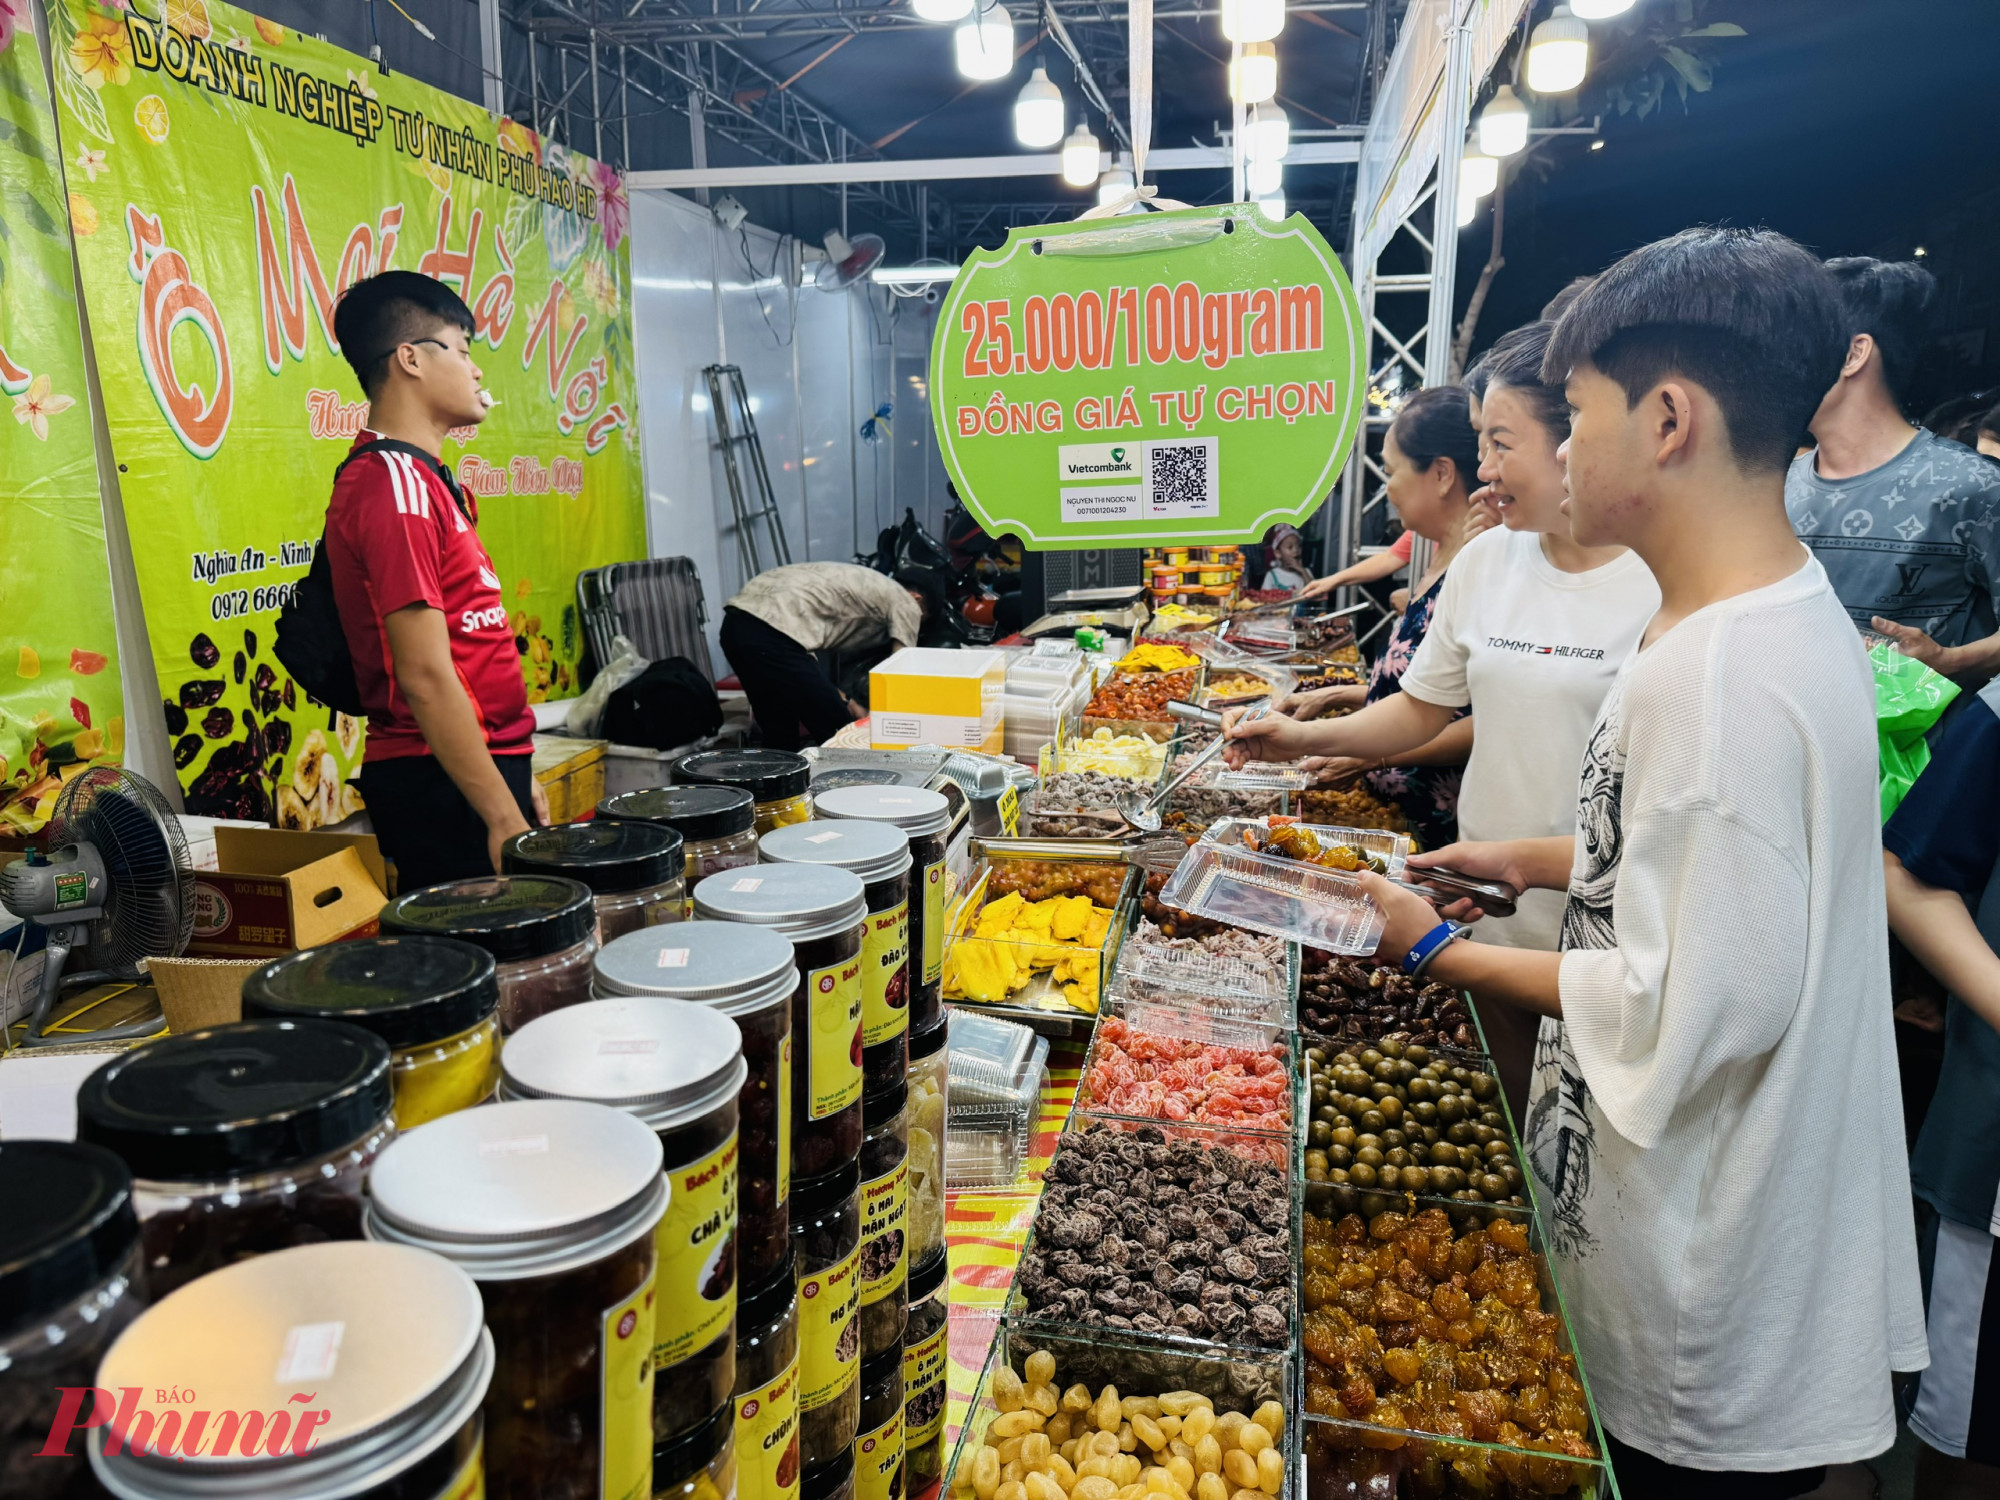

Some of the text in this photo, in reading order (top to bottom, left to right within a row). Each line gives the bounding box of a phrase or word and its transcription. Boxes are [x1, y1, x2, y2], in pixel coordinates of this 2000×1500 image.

[125, 10, 597, 220] DOANH NGHIỆP TƯ NHÂN PHÚ HÀO HD
[125, 202, 234, 461] Ô
[418, 194, 515, 350] Hà
[961, 280, 1324, 378] 25.000/100gram
[957, 380, 1335, 437] ĐỒNG GIÁ TỰ CHỌN
[1068, 461, 1132, 474] Vietcombank
[1066, 495, 1137, 505] NGUYEN THI NGOC NU
[1076, 506, 1127, 515] 0071001204230
[240, 546, 265, 573] An
[280, 540, 312, 567] Ninh
[210, 590, 249, 621] 0972
[460, 601, 506, 633] Snap
[1487, 637, 1605, 661] TOMMY HILFIGER
[881, 950, 900, 967] ĐÀO
[866, 1179, 895, 1200] Hương
[867, 1195, 894, 1217] Ô MAI
[690, 1209, 721, 1245] CHÀ
[861, 1217, 886, 1237] MẶN
[828, 1265, 850, 1287] Bách
[917, 1352, 939, 1373] Ô MAI
[878, 1454, 896, 1475] TÁO
